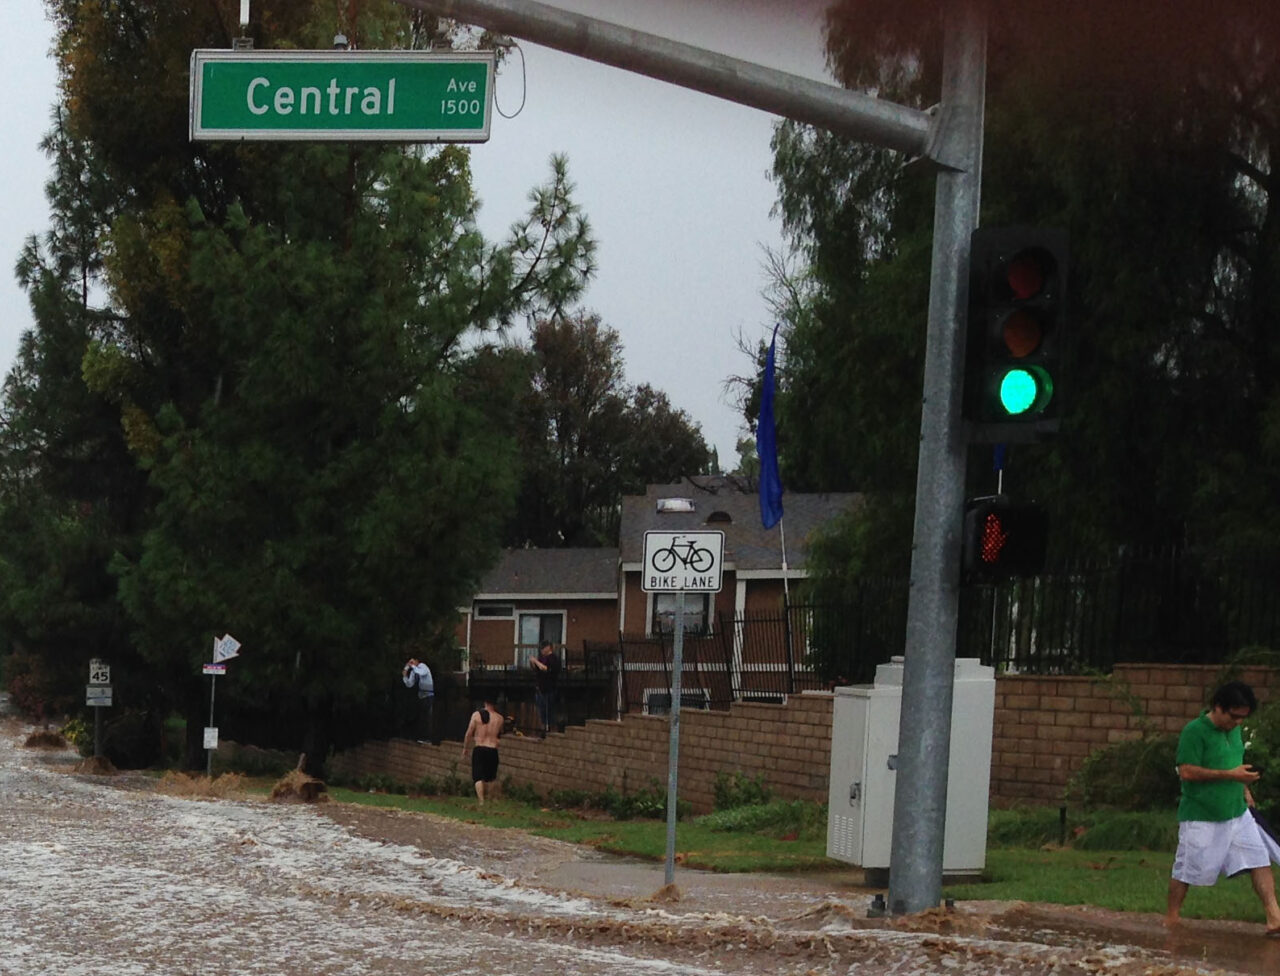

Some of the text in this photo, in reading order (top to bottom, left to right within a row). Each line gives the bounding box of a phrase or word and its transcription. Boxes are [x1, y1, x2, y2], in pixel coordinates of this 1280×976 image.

[447, 77, 477, 93] Ave
[246, 77, 396, 115] Central
[441, 100, 480, 115] 1500
[651, 576, 714, 588] BIKE LANE
[92, 671, 109, 682] 45
